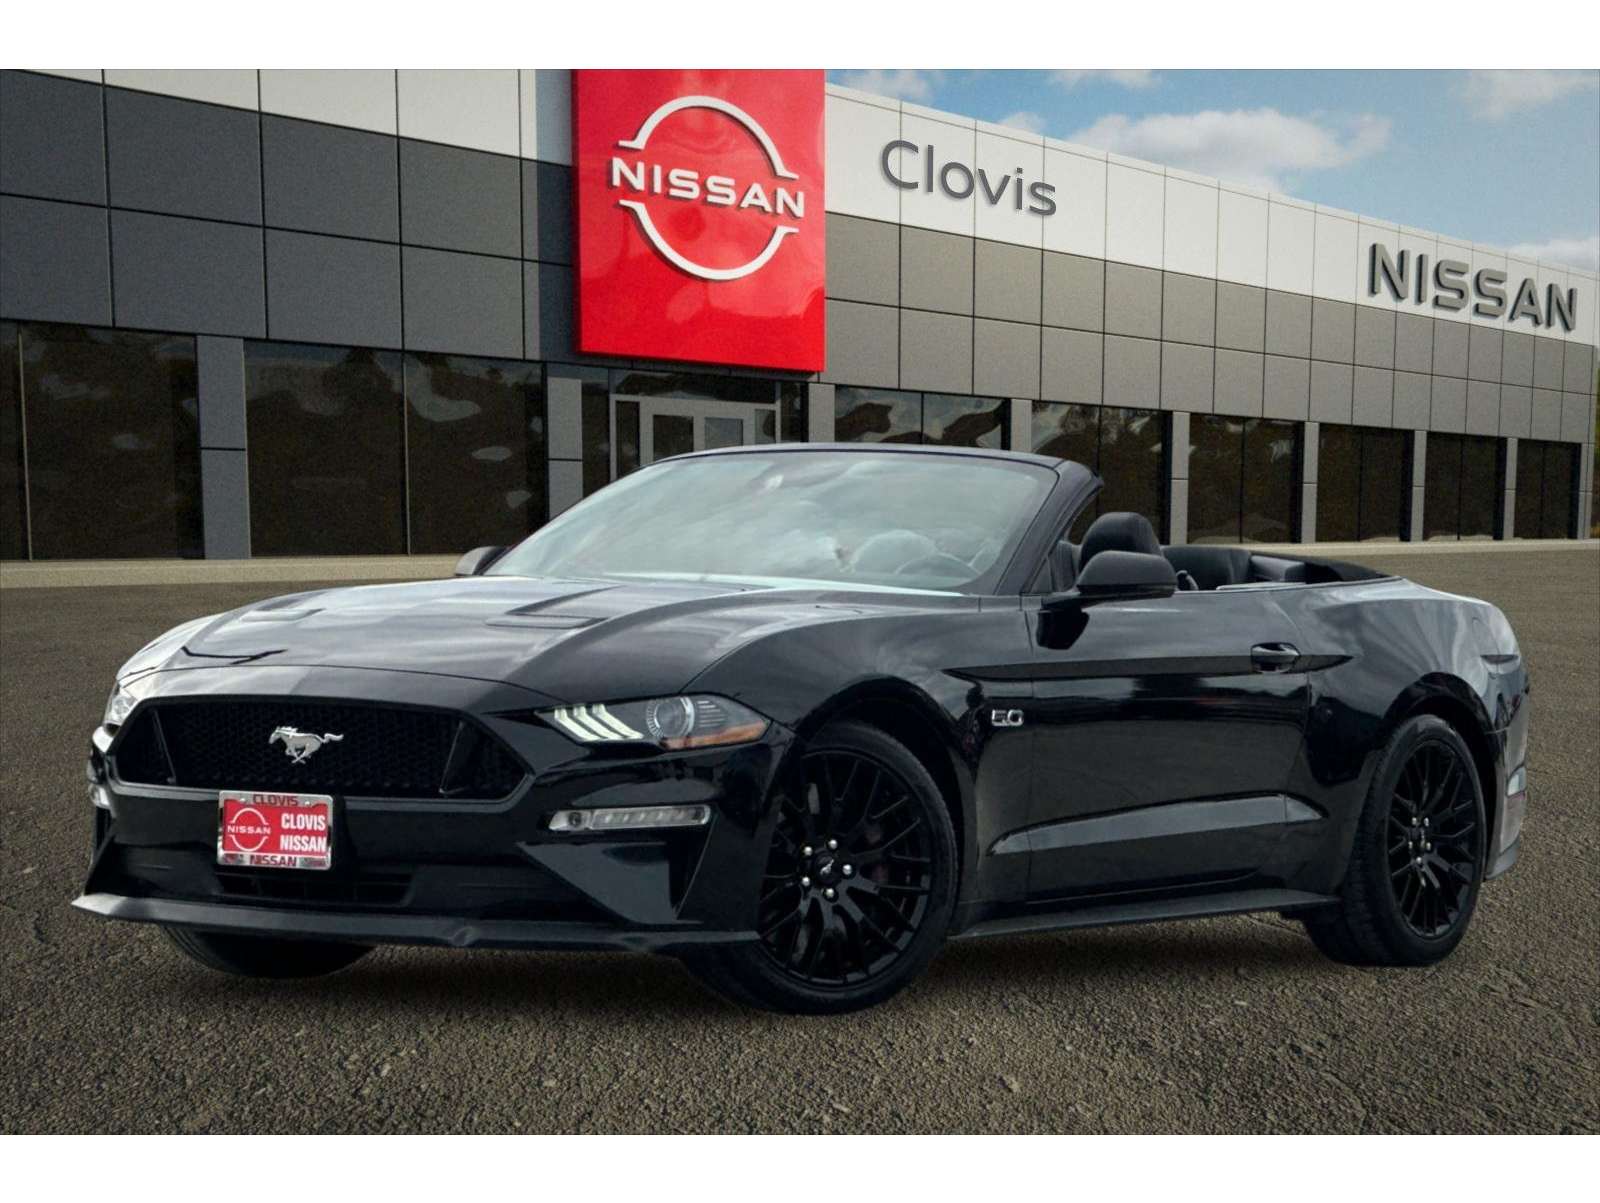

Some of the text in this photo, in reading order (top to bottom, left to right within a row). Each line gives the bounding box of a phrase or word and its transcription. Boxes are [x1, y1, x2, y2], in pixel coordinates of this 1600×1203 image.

[611, 156, 805, 218] NISSAN
[882, 140, 1057, 217] Clovis
[1368, 242, 1578, 332] NISSAN
[252, 794, 299, 806] CLOVIS
[227, 825, 271, 835] NISSAN
[281, 813, 326, 831] CLOVIS
[279, 834, 327, 852] NISSAN
[249, 854, 297, 867] NISSAN
